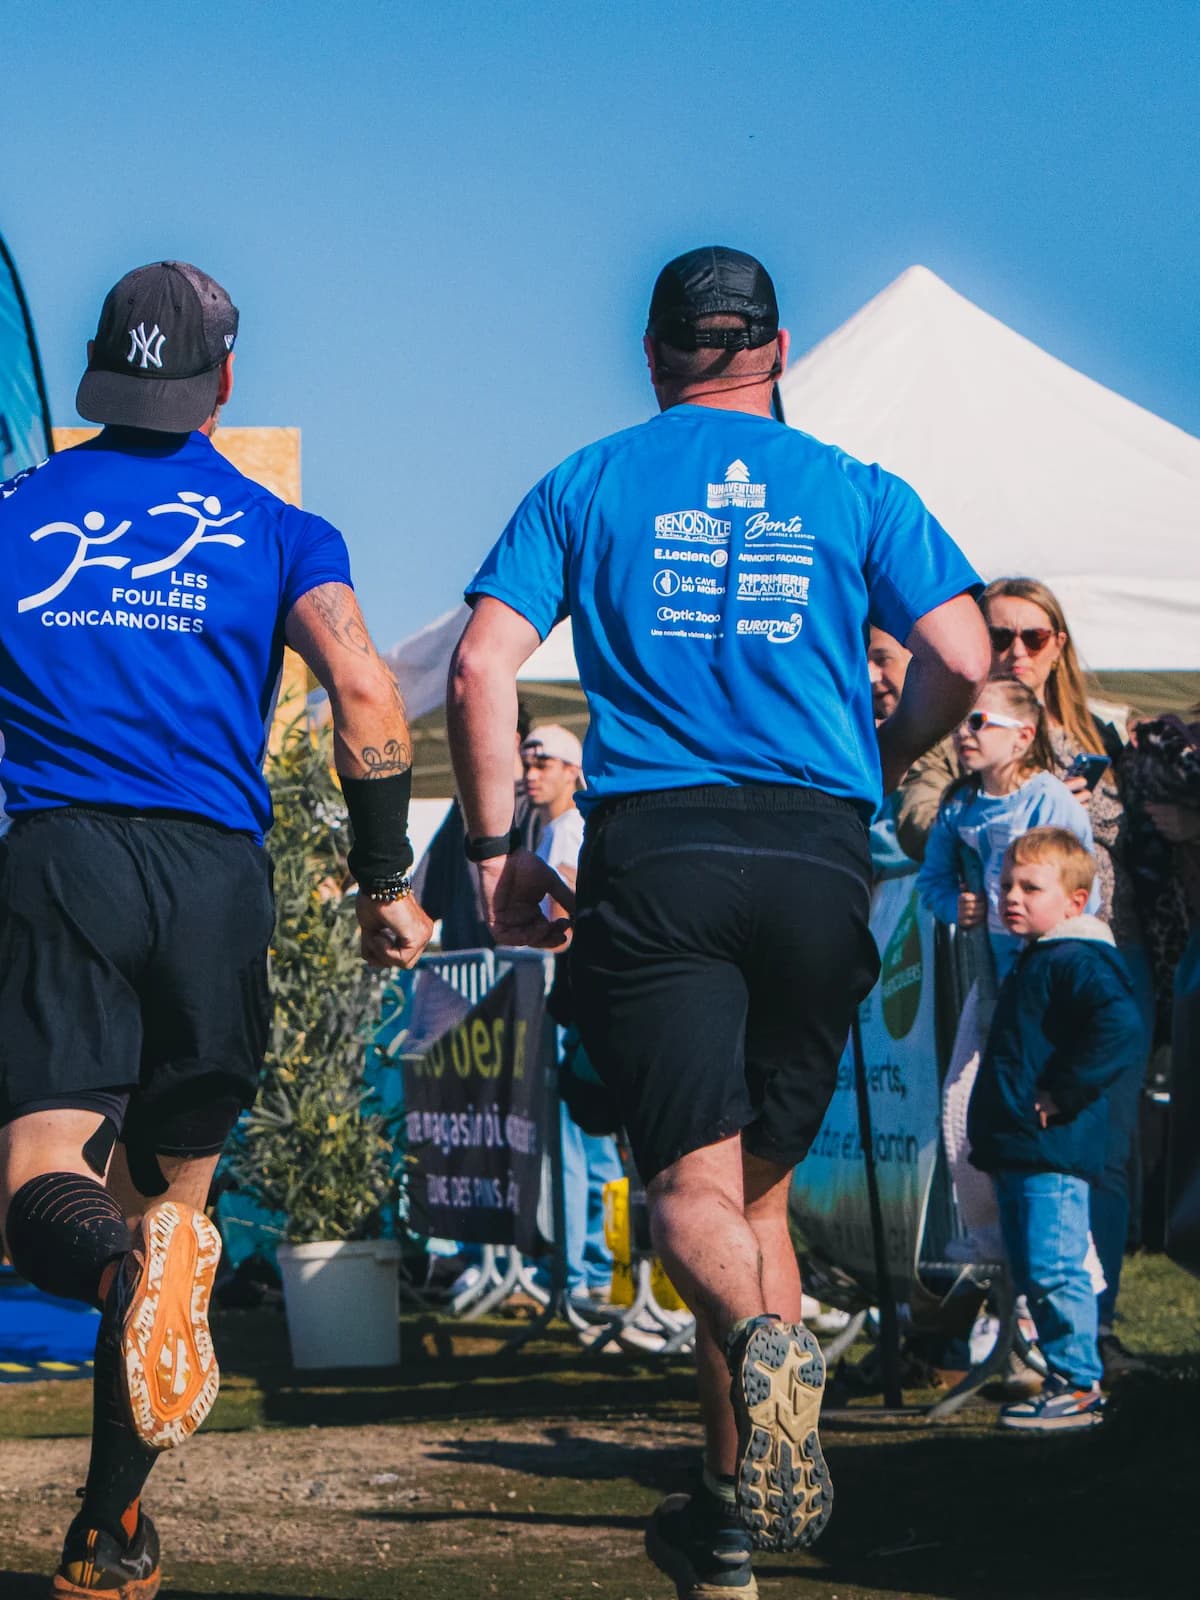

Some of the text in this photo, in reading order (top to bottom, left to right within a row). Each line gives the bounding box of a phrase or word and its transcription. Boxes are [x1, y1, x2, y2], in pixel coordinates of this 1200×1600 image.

[126, 321, 167, 369] NY
[653, 548, 711, 564] E.Leclerc
[170, 570, 209, 589] LES
[681, 576, 717, 586] LA CAVE
[738, 572, 810, 586] IMPRIMERIE
[681, 584, 696, 593] DU
[738, 583, 808, 598] ATLANTIQUE
[111, 587, 207, 611] FOULÉES
[40, 610, 204, 633] CONCARNOISES
[656, 606, 695, 623] Optic
[736, 619, 797, 635] EUROTYRE
